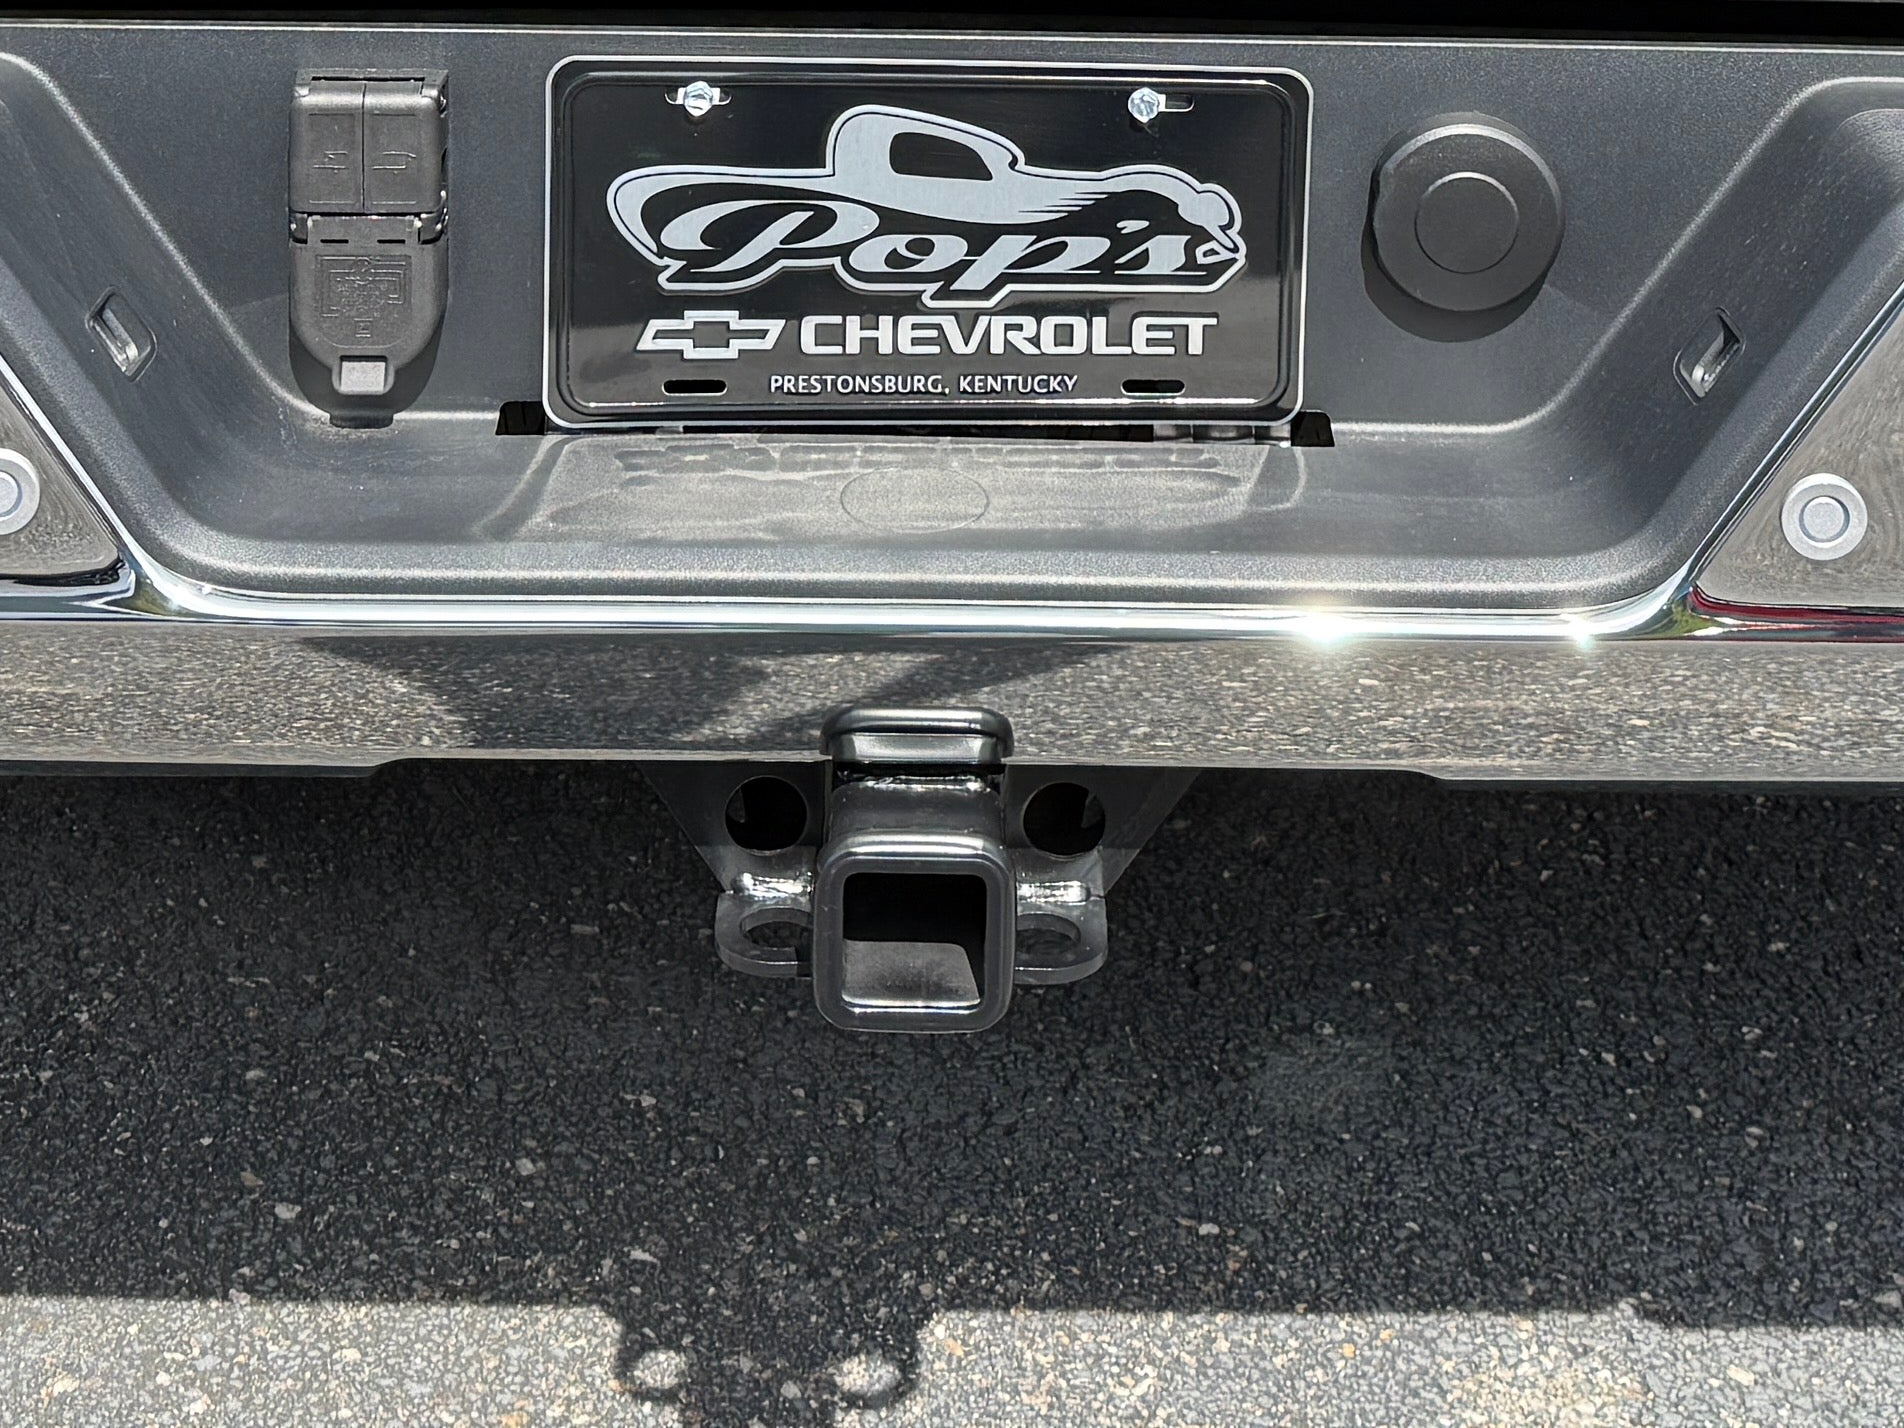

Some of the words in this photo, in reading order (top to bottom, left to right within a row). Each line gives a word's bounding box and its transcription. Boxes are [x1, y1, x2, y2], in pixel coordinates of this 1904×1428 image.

[659, 197, 1208, 292] Pop's
[800, 315, 1219, 356] CHEVROLET
[769, 375, 951, 396] PRESTONSBURG,
[959, 375, 1079, 394] KENTUCKY
